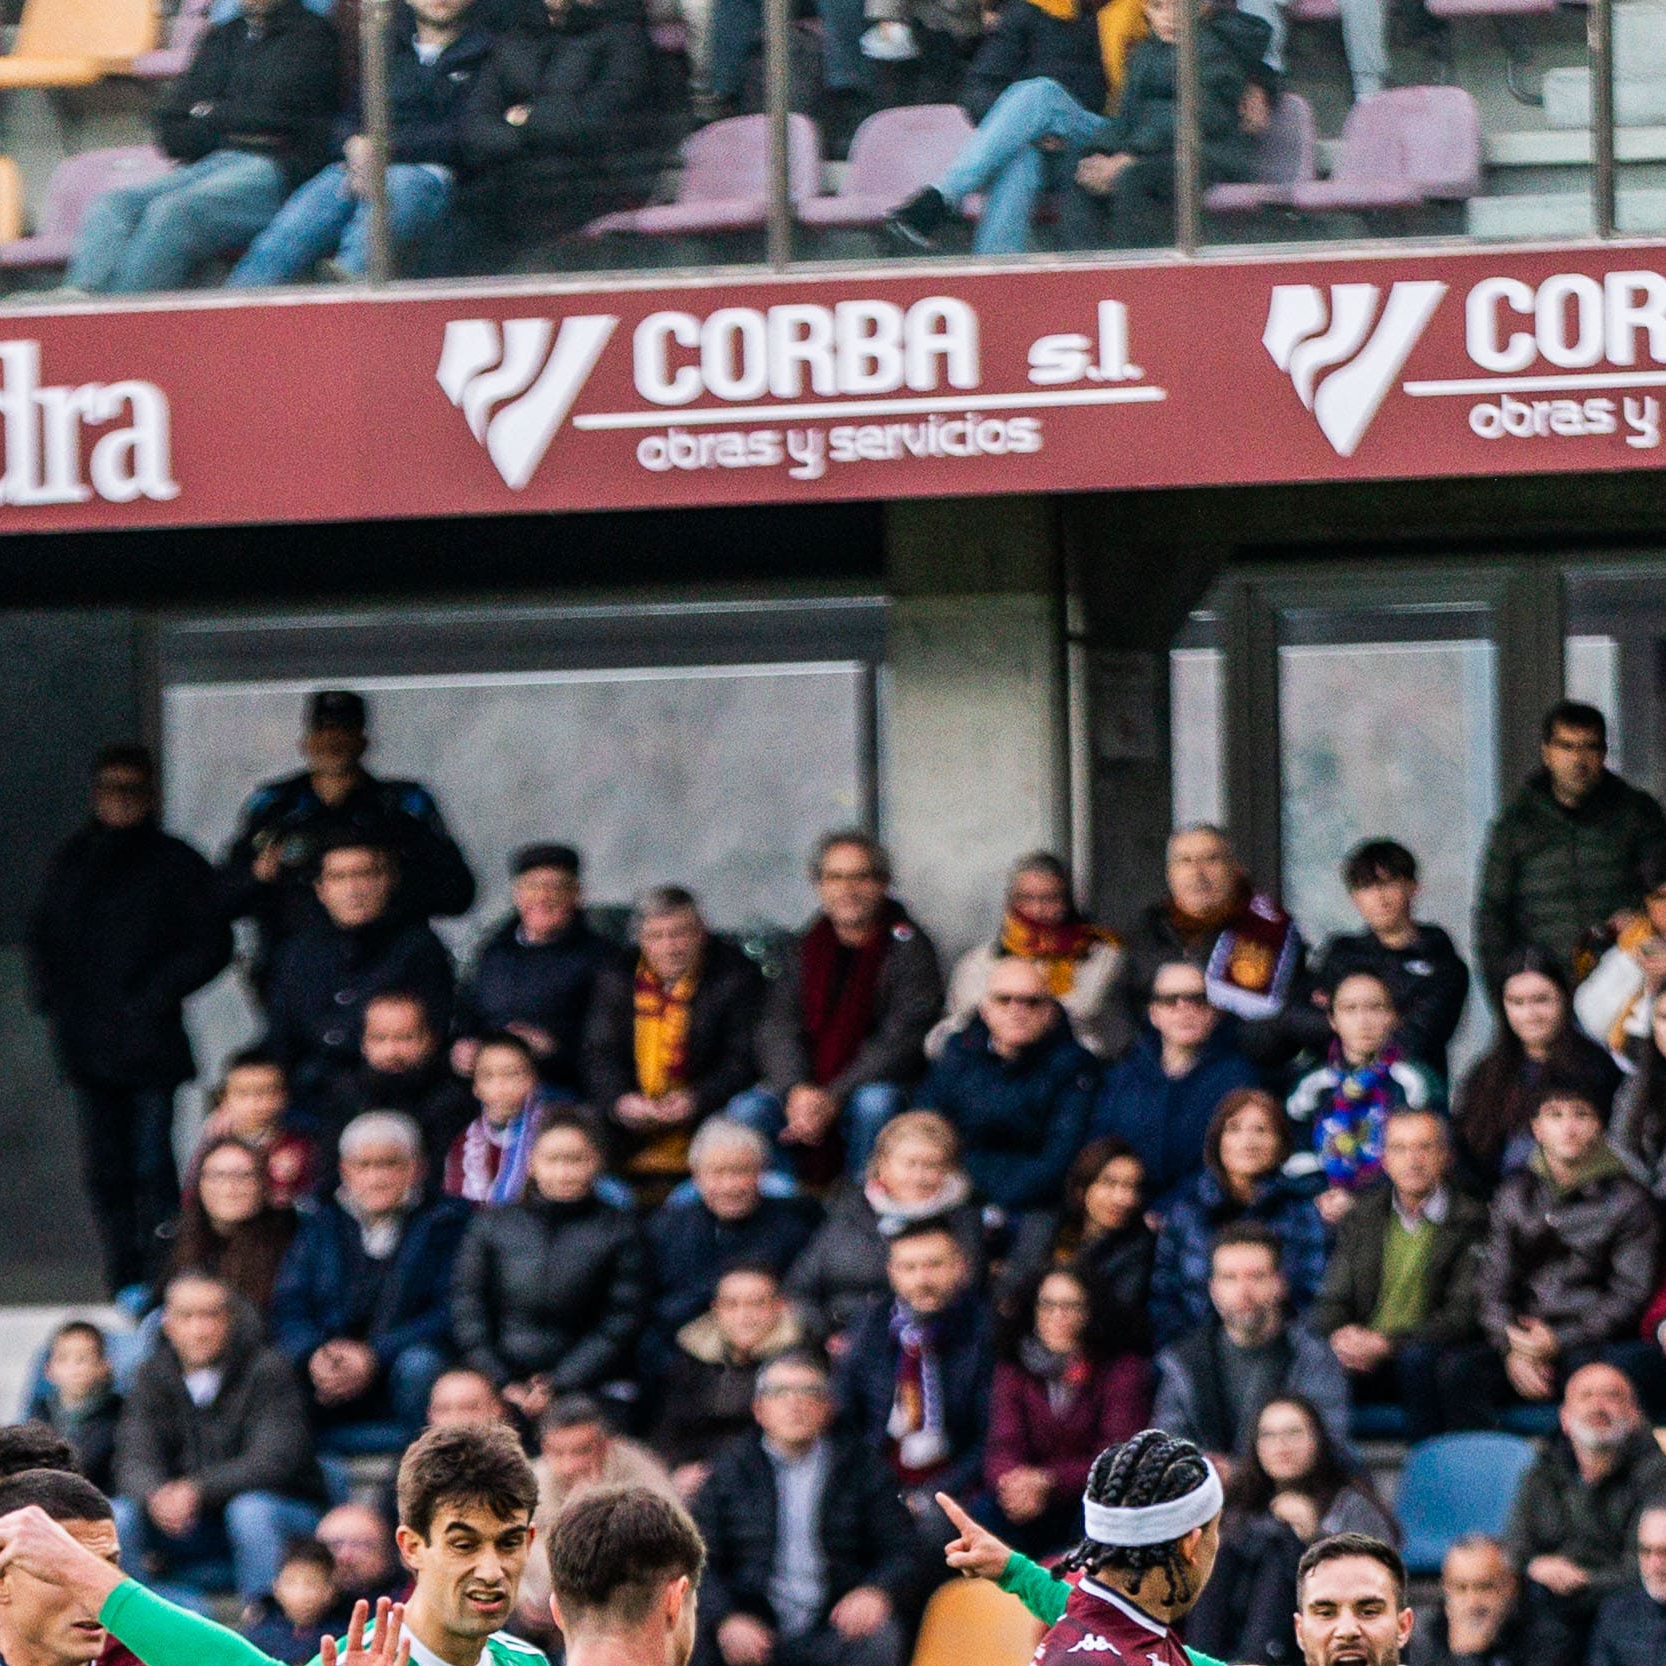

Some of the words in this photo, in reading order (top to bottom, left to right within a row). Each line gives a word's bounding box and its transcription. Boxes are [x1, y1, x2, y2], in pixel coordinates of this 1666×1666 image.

[632, 295, 981, 402] CORBA
[636, 427, 783, 473] obras
[786, 430, 827, 480] y
[829, 413, 1044, 462] servicios
[1469, 393, 1619, 440] obras
[1623, 396, 1662, 449] y
